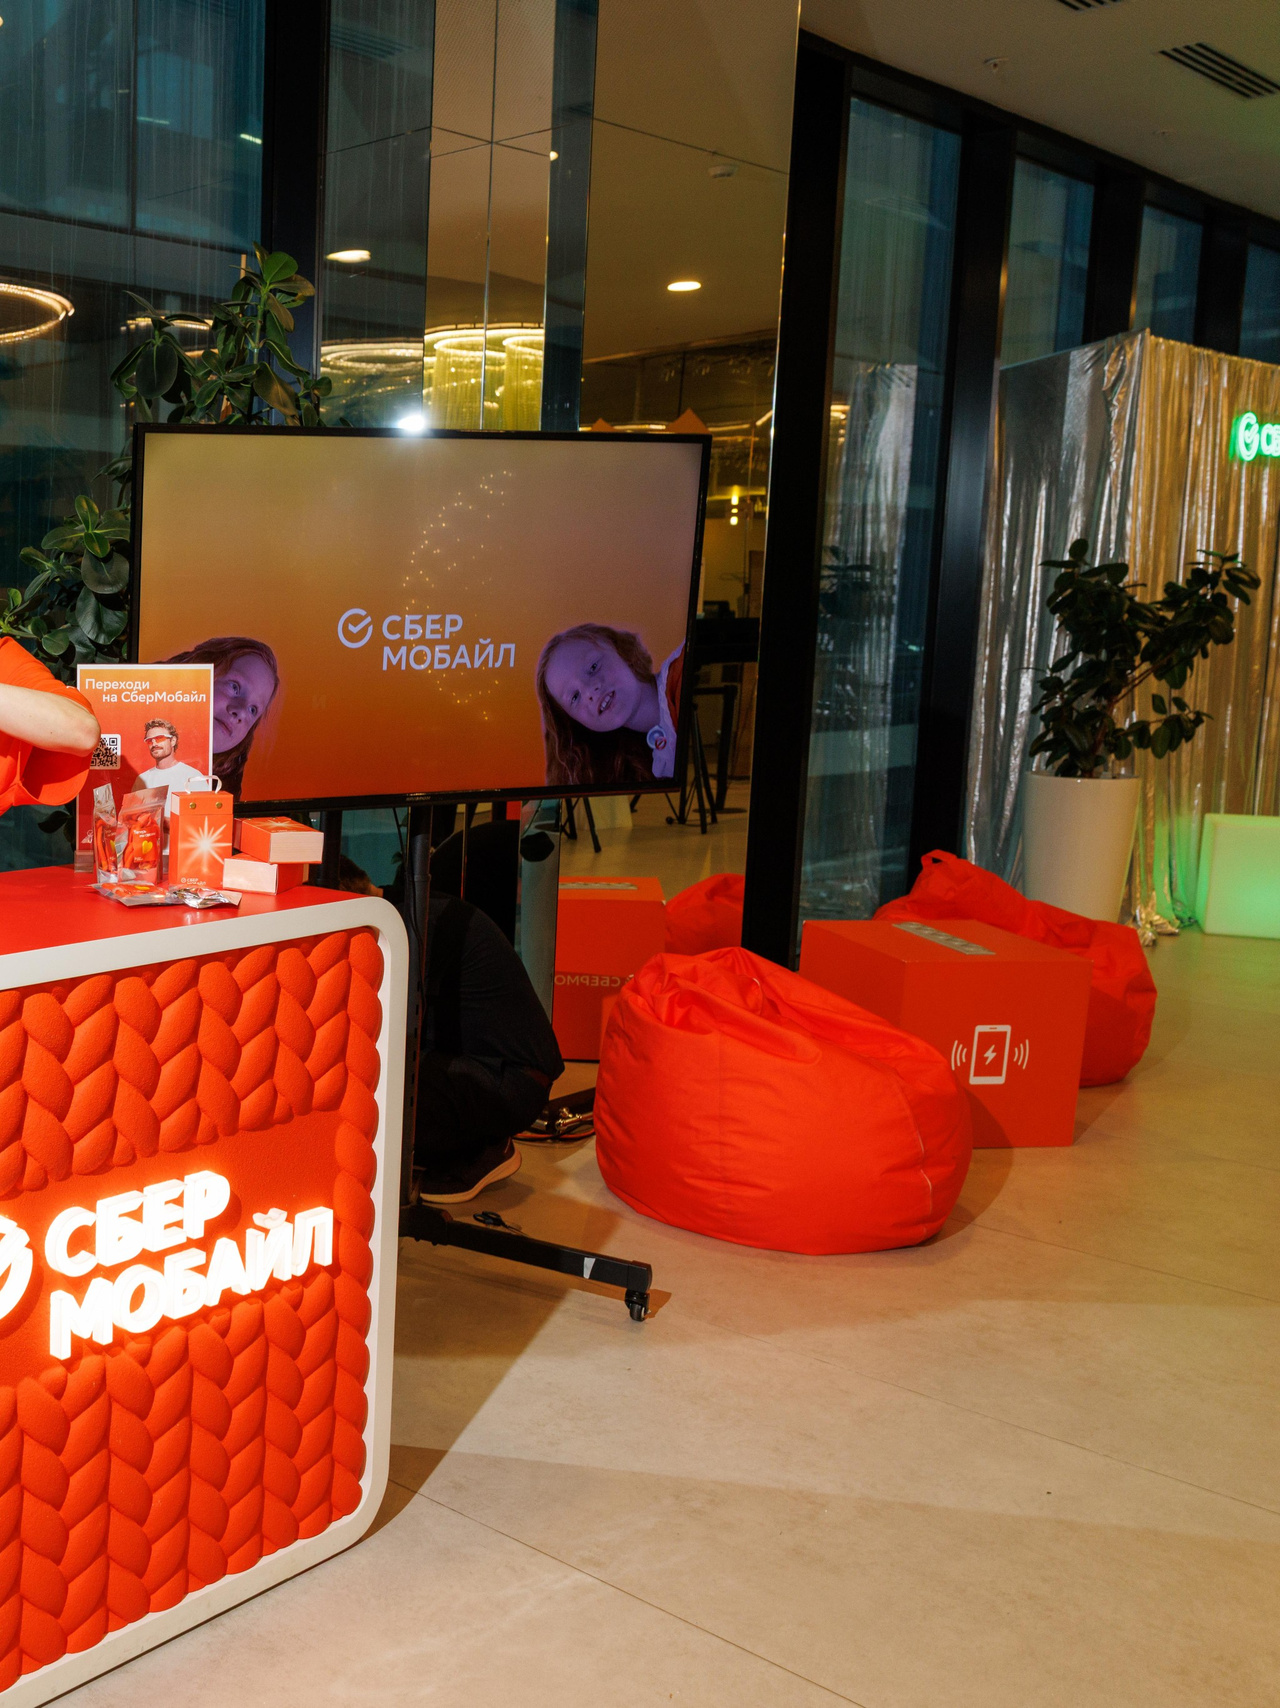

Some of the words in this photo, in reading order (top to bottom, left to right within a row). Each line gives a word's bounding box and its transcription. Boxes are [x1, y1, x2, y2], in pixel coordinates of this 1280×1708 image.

[382, 614, 463, 640] СБЕР
[382, 638, 516, 671] МОБАЙЛ
[85, 678, 150, 691] Переходи
[102, 693, 118, 703] на
[121, 690, 207, 704] СберМобайл
[44, 1170, 231, 1277] СБЕР
[49, 1206, 333, 1360] МОБАЙЛ
